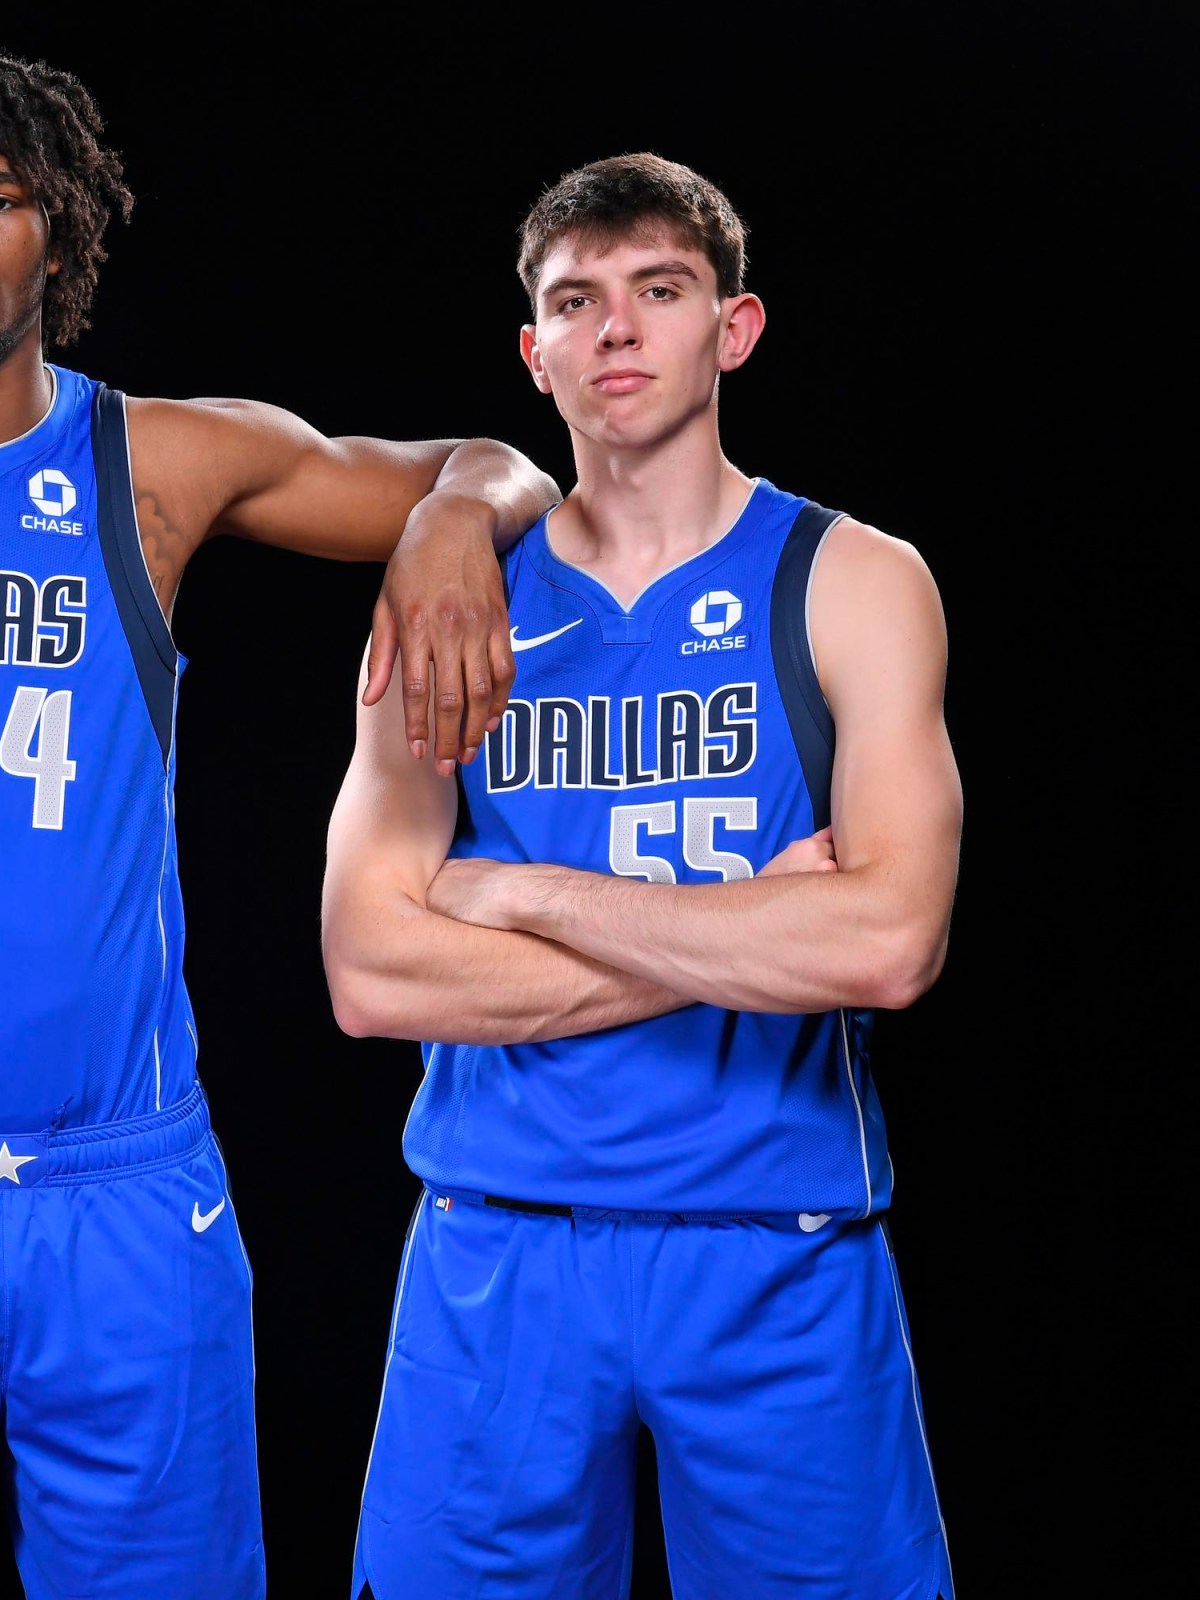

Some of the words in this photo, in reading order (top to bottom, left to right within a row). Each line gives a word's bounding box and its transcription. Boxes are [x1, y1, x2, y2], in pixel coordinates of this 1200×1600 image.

[21, 515, 84, 536] CHASE
[681, 635, 746, 655] CHASE
[485, 682, 757, 794] DALLAS
